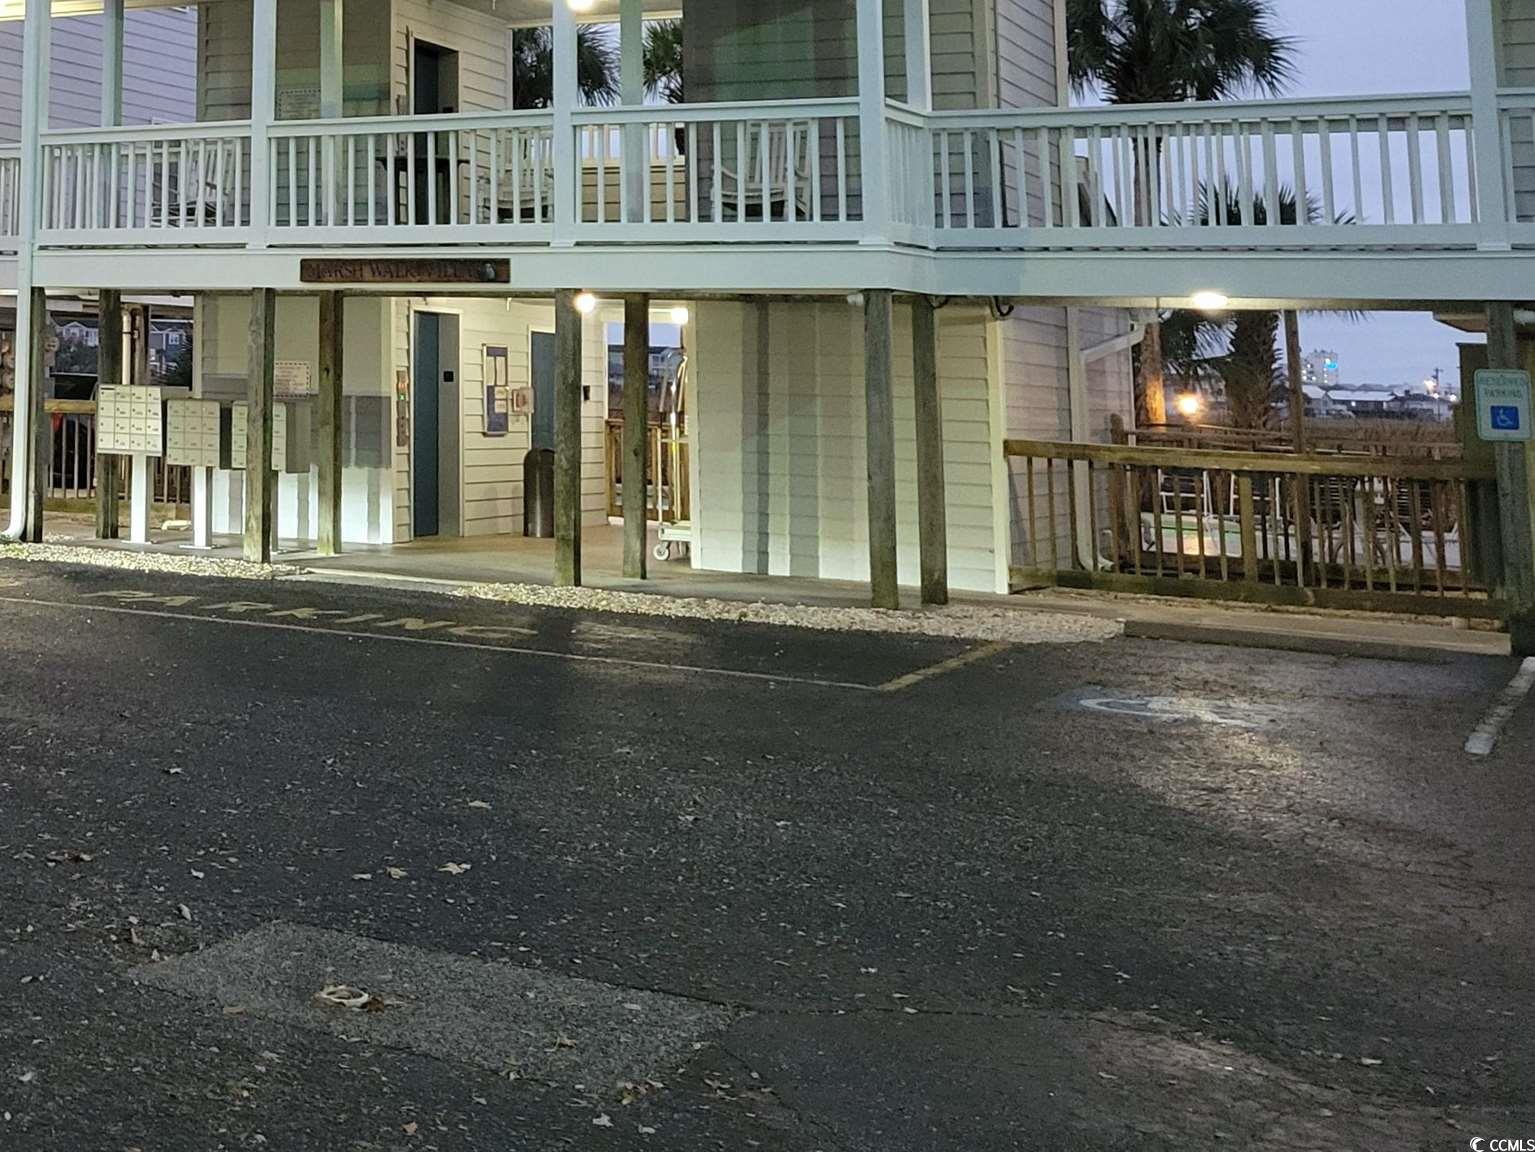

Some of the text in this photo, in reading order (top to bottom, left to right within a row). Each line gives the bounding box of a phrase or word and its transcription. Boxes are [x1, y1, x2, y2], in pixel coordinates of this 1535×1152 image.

[303, 261, 364, 280] MARSH
[370, 261, 418, 280] WALK
[79, 590, 539, 638] PARKING
